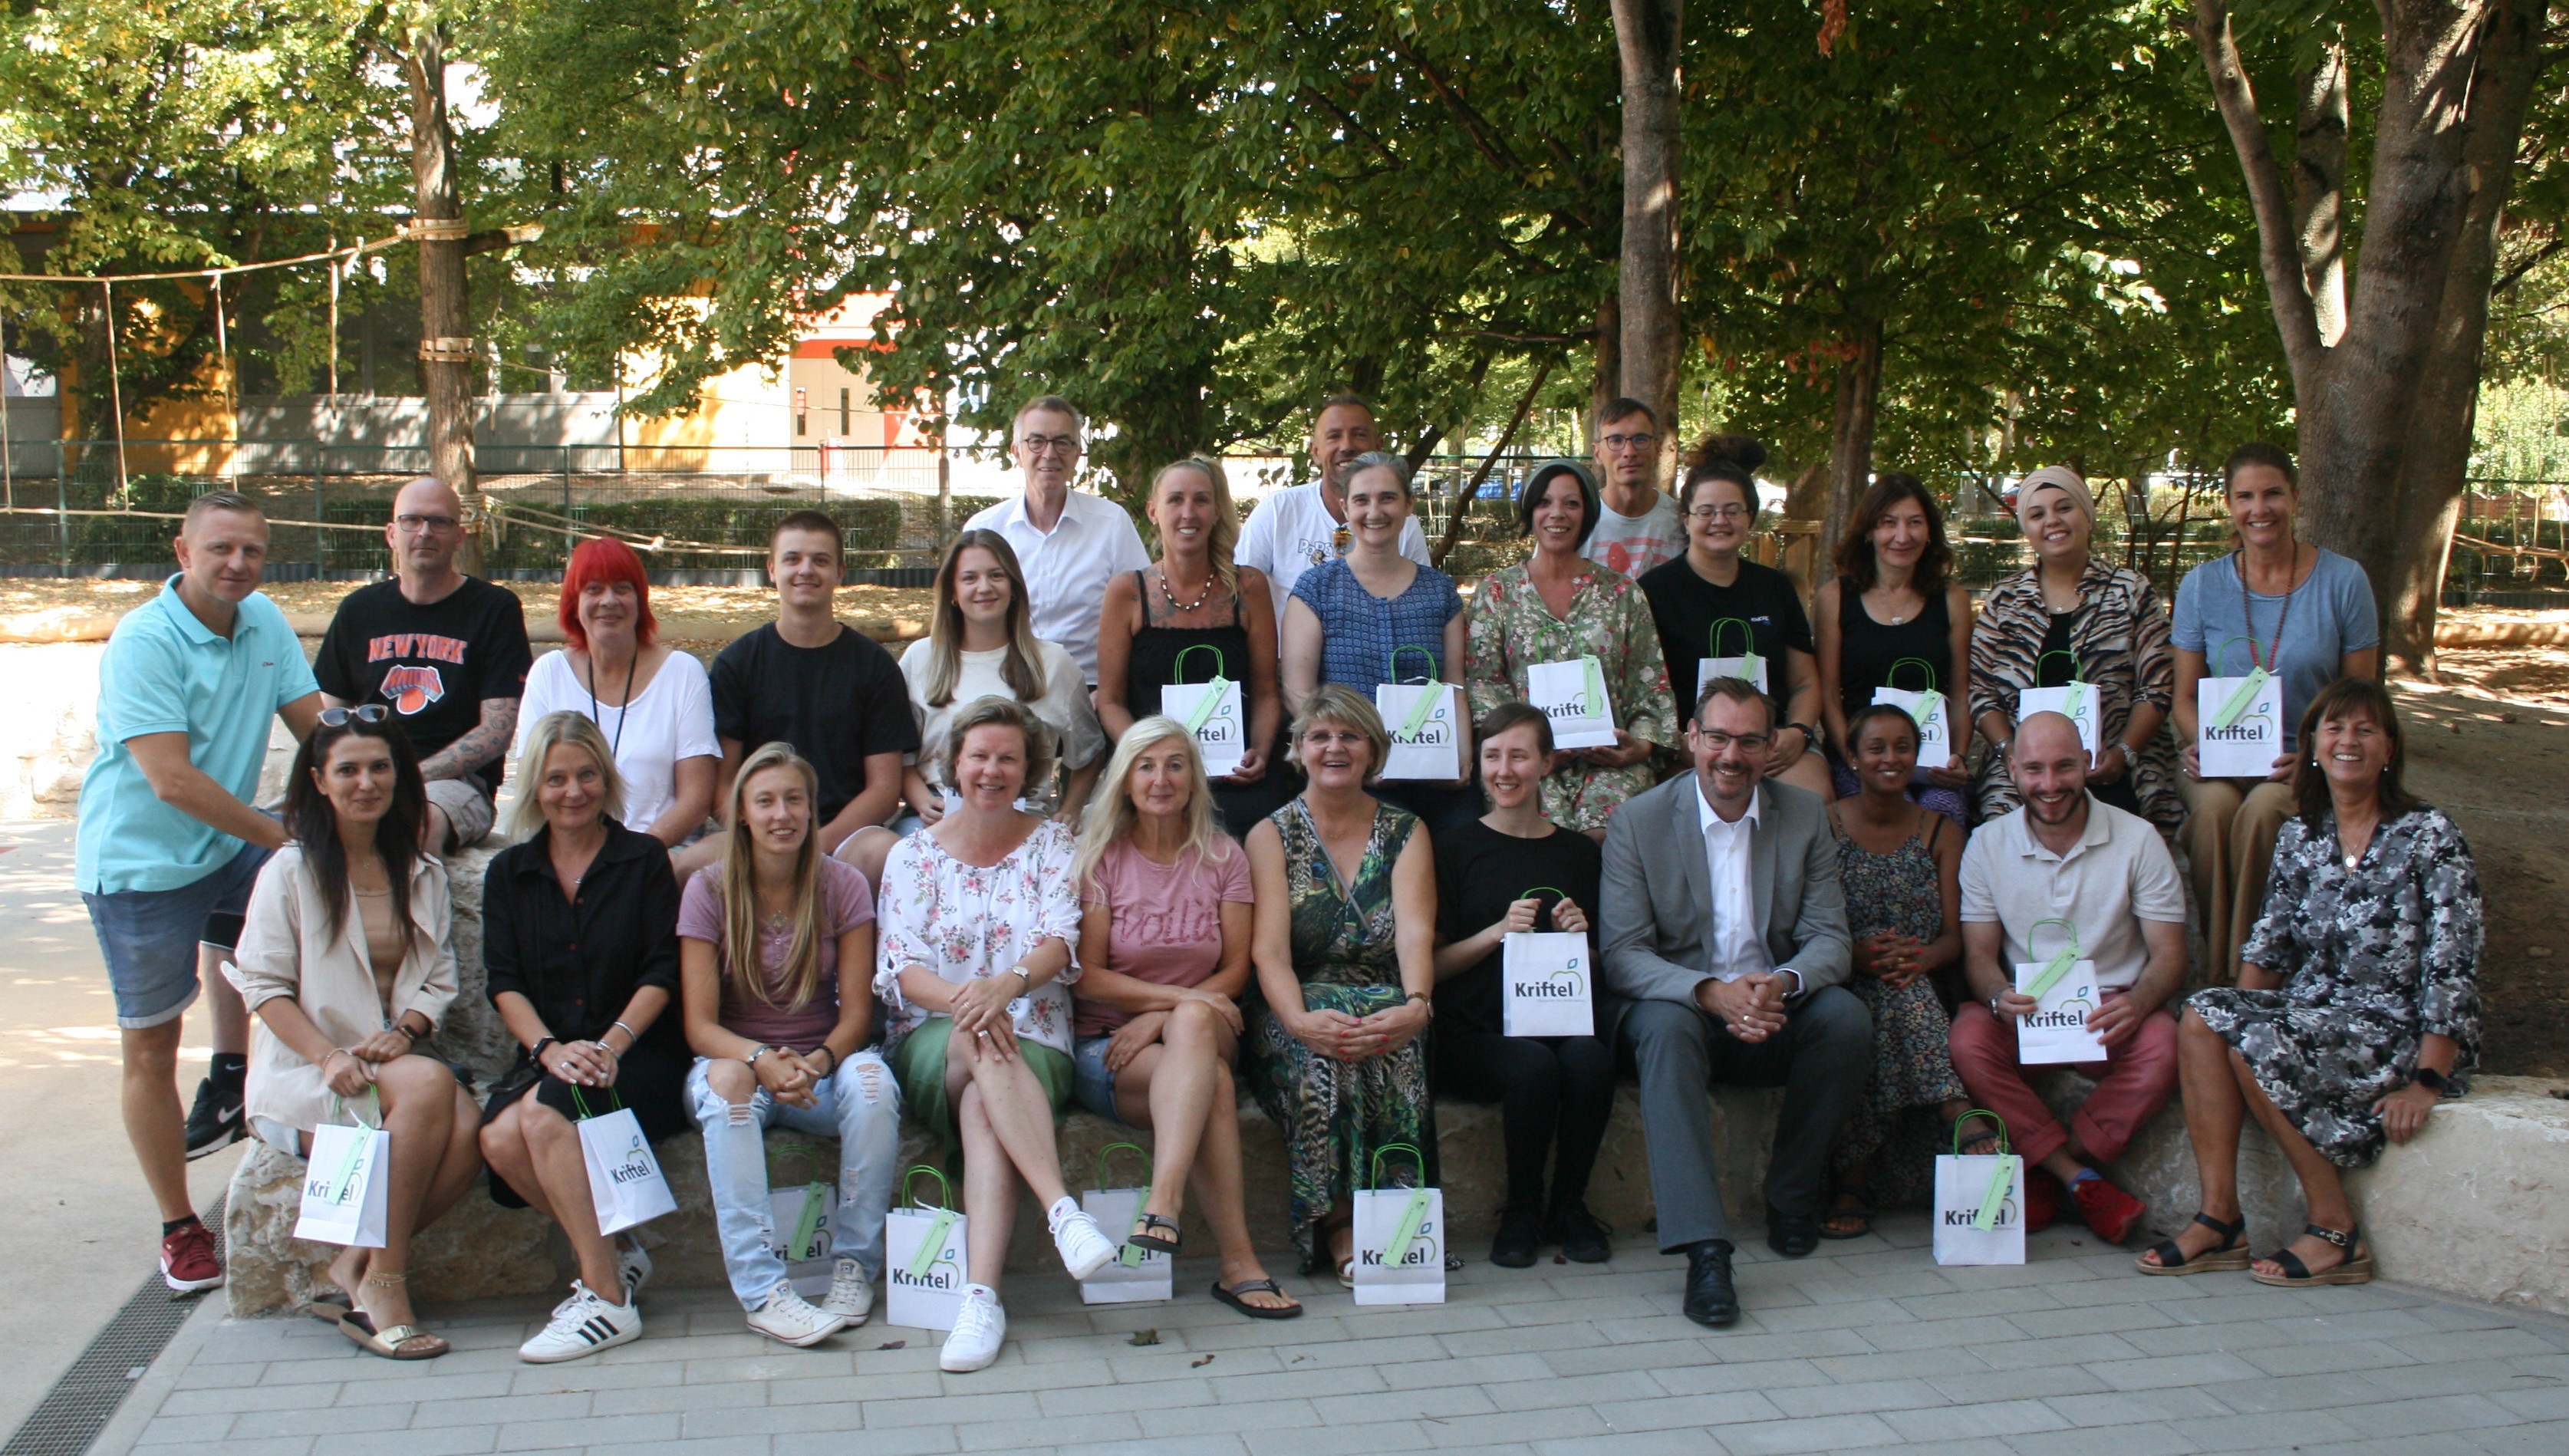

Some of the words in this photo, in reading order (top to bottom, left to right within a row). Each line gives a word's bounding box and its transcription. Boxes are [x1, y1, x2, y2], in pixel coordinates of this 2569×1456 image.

[368, 633, 416, 663] NEW
[415, 633, 467, 664] YORK
[1540, 702, 1586, 718] Krifte
[2205, 725, 2263, 740] Kriftel
[1515, 981, 1573, 997] Kriftel
[2024, 1010, 2083, 1028] Kriftel
[611, 1159, 650, 1184] Kriftel
